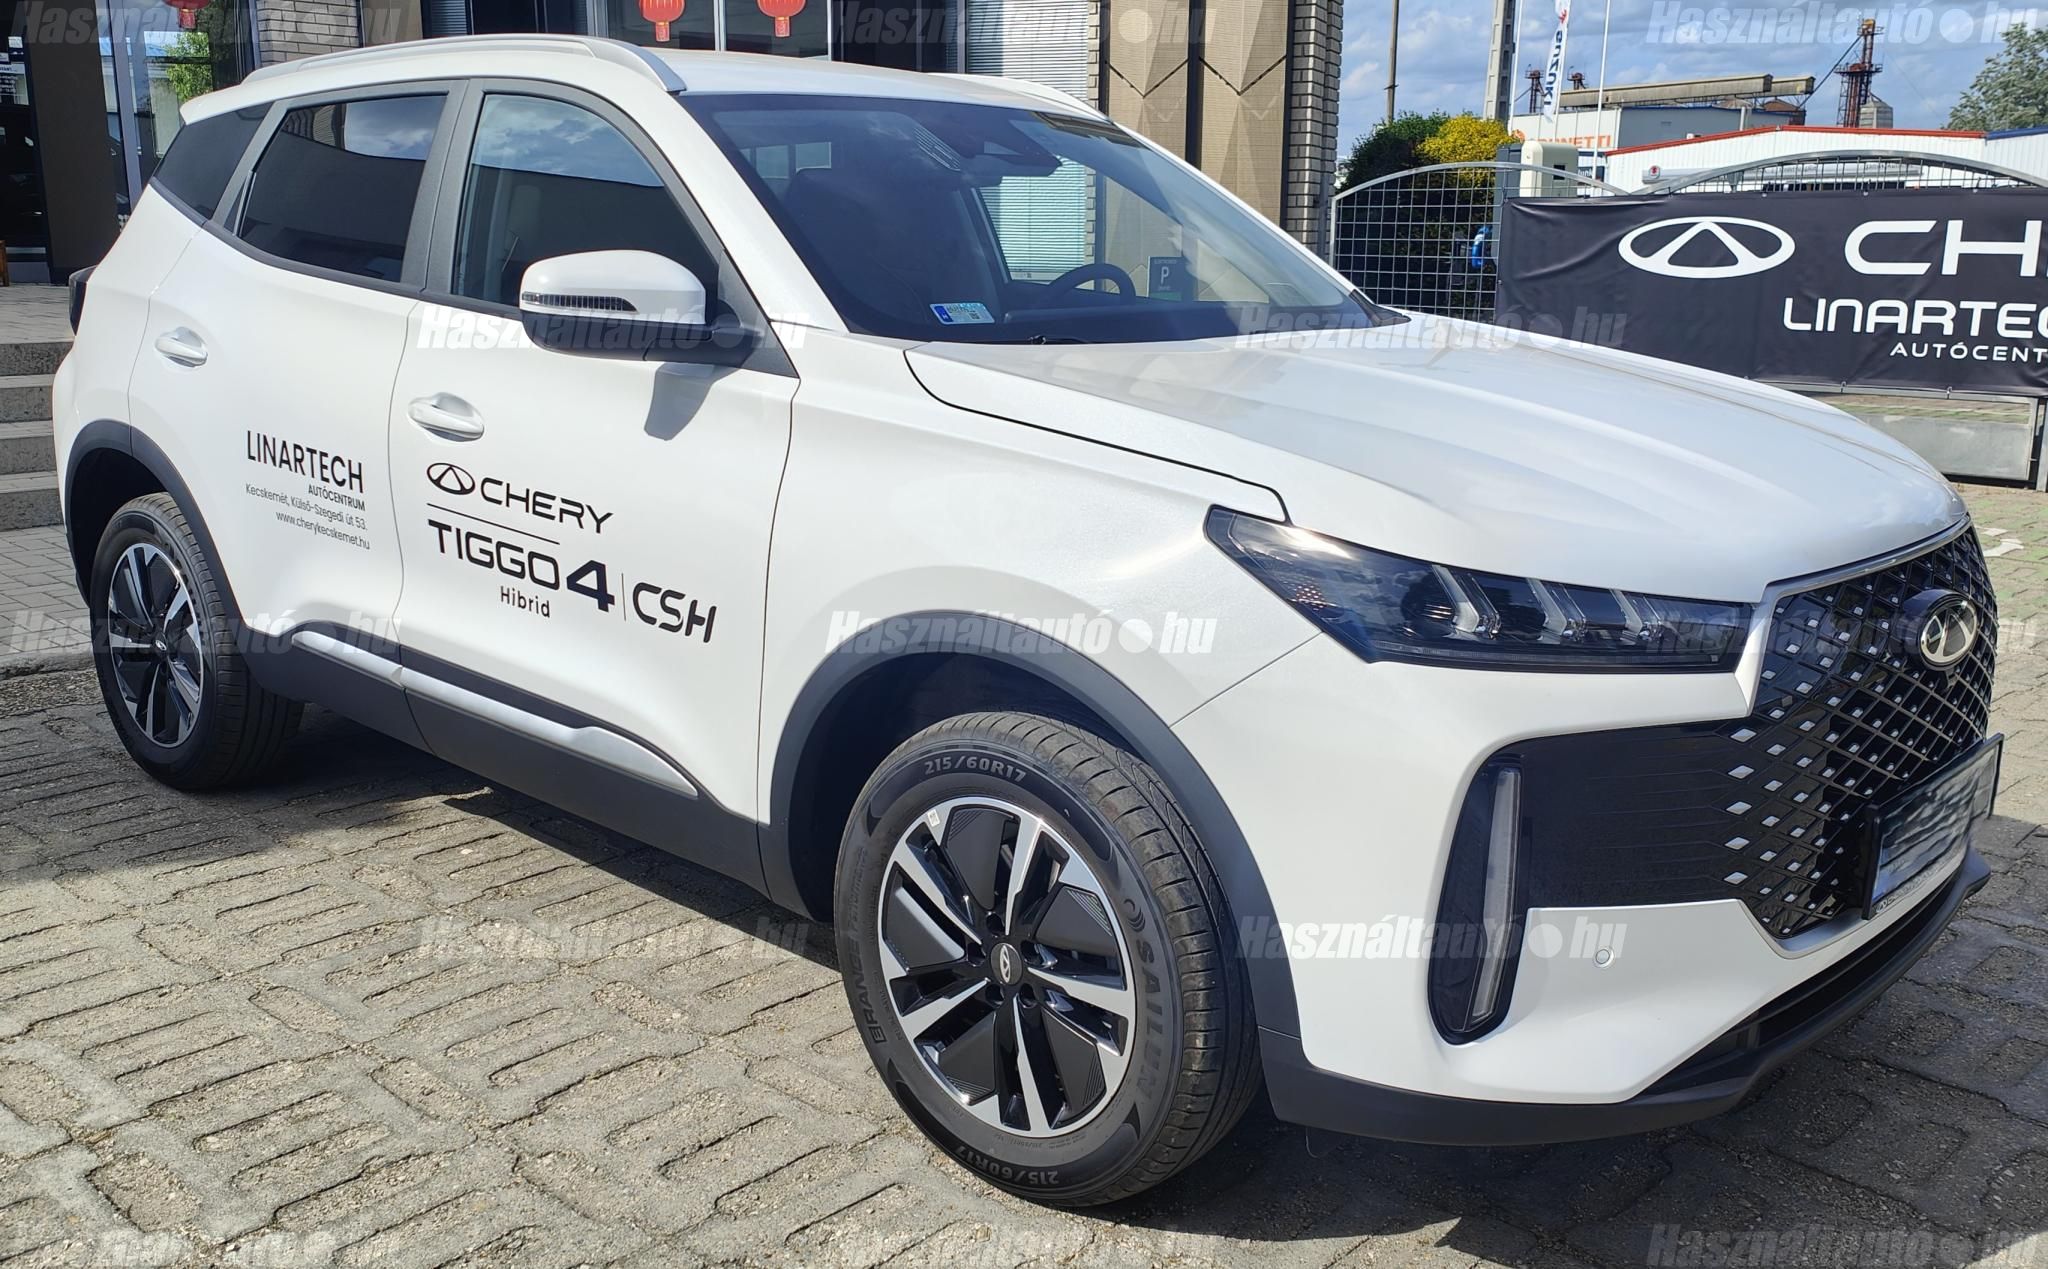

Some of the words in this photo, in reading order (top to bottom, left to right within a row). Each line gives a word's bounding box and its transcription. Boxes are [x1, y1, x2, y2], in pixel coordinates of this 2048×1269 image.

[1845, 220, 2048, 277] CH
[247, 430, 364, 494] LINARTECH
[246, 483, 290, 507] Kecskemét,
[308, 484, 366, 512] AUTÓCENTRUM
[480, 477, 614, 534] CHERY
[276, 511, 370, 550] www.cherykecskemet.hu
[500, 585, 551, 618] Hibrid
[632, 582, 717, 644] CSH
[924, 755, 1027, 782] 215/60R17
[1116, 939, 1163, 1098] SAILUN
[957, 1145, 1060, 1185] 215/60R17
